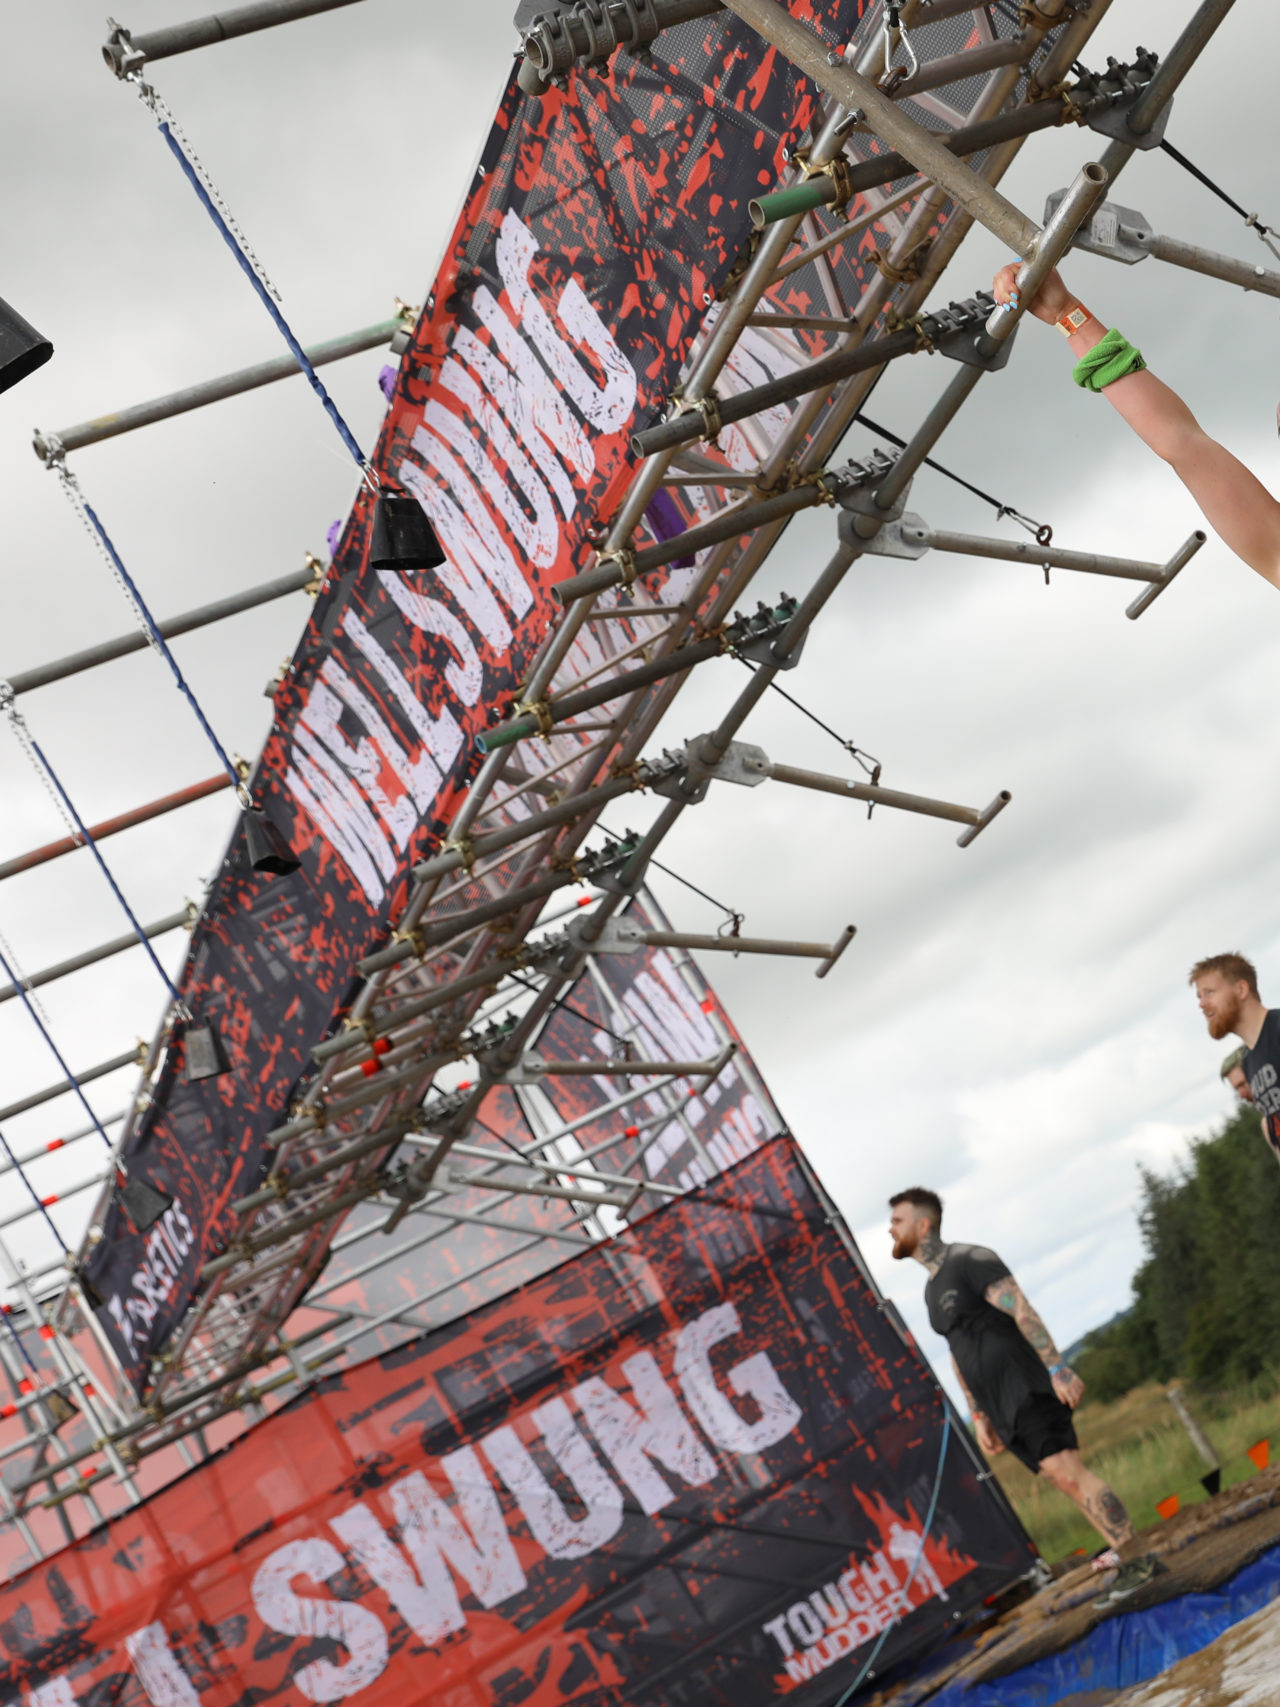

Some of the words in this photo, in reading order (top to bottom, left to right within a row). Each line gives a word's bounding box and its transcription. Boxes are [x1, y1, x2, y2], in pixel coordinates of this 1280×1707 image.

[284, 608, 464, 909] WELL
[377, 207, 637, 707] SWUNG
[250, 1302, 802, 1703] SWUNG
[763, 1551, 900, 1658] TOUGH
[783, 1588, 916, 1683] MUDDER
